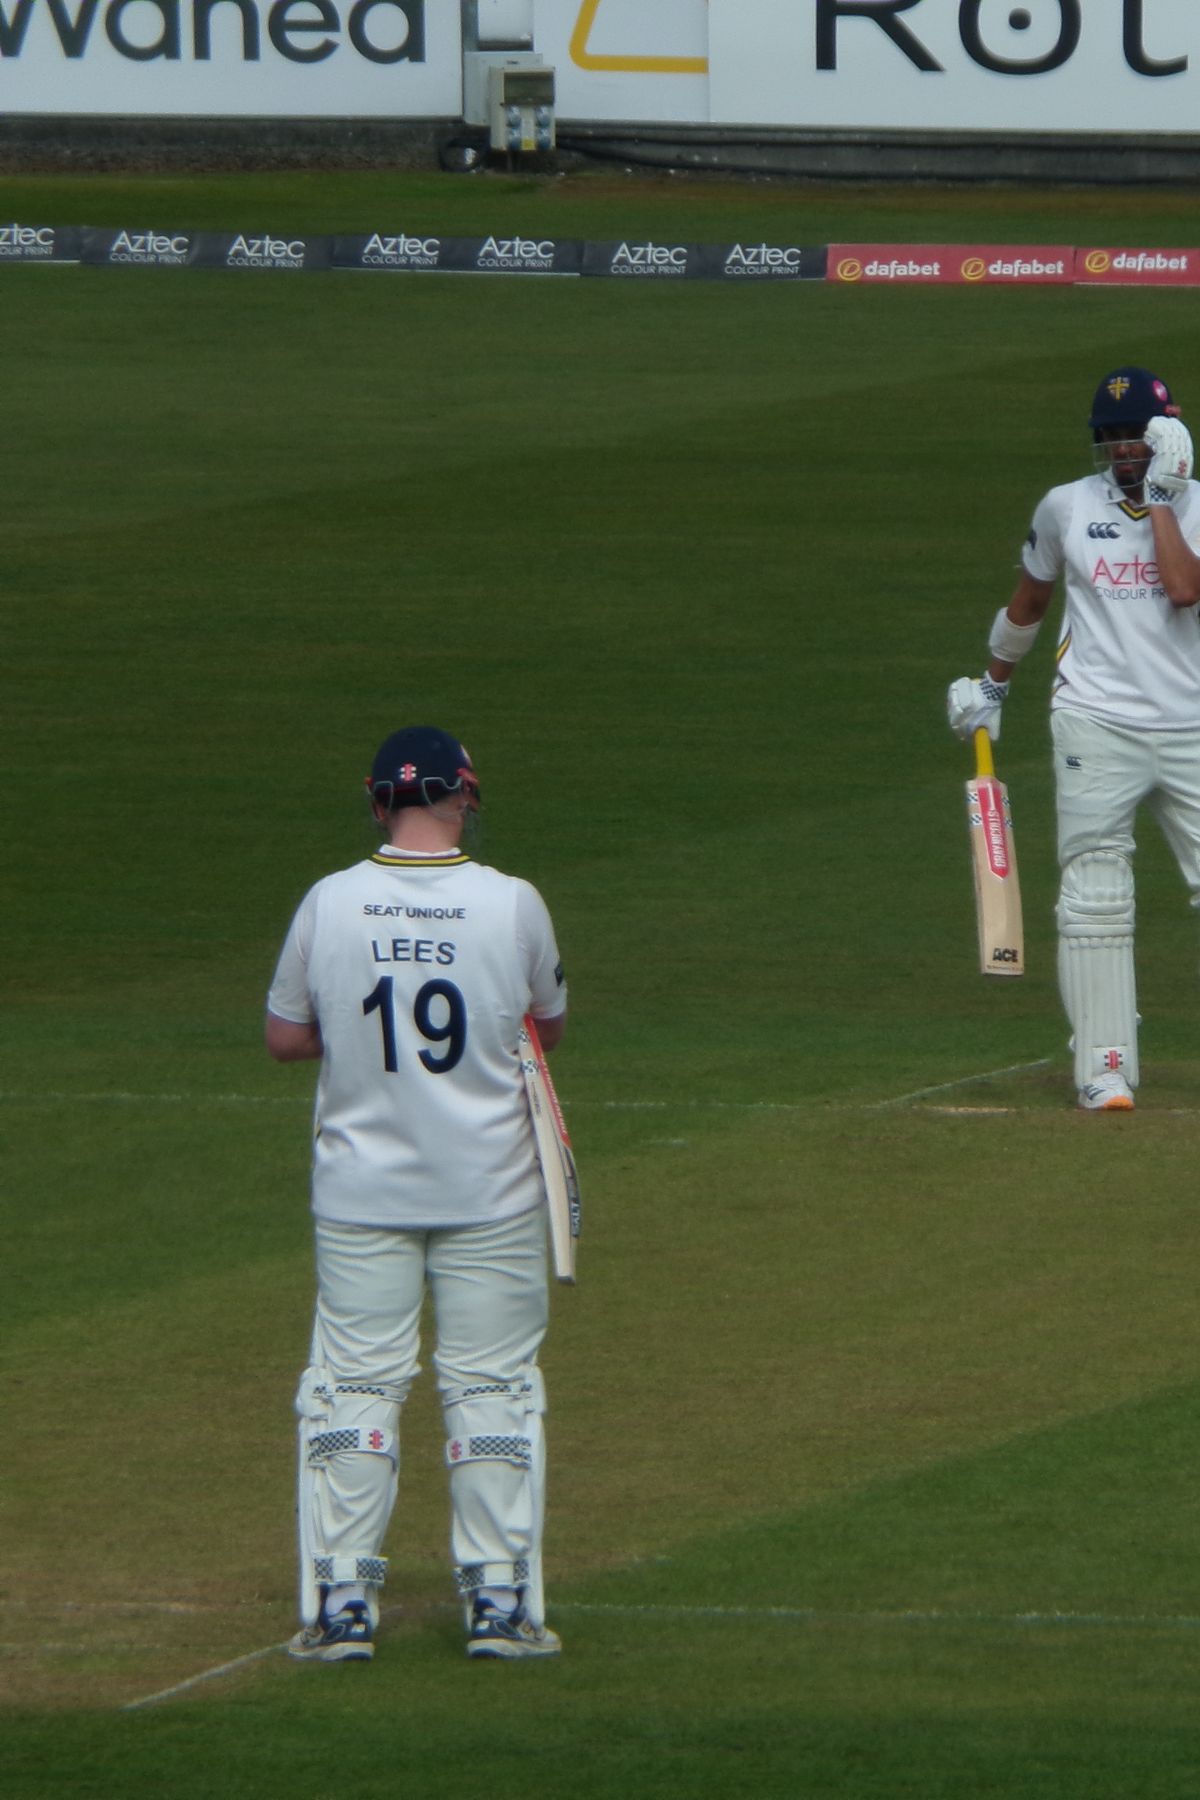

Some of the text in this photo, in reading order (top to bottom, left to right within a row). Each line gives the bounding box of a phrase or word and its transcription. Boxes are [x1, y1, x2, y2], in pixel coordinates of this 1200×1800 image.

[0, 223, 54, 246] ztec
[112, 230, 188, 253] Aztec
[363, 233, 440, 256] Aztec
[229, 235, 305, 258] Aztec
[479, 236, 555, 258] Aztec
[612, 242, 687, 265] Aztec
[726, 243, 801, 266] Aztec
[110, 253, 187, 264] COLOUR PRINT
[227, 257, 304, 268] COLOUR PRINT
[362, 255, 438, 265] COLOUR PRINT
[477, 258, 552, 268] COLOUR PRINT
[989, 260, 1064, 277] dafabet
[1113, 253, 1188, 271] dafabet
[611, 264, 686, 274] COLOUR PRINT
[725, 265, 799, 275] COLOUR PRINT
[865, 260, 940, 278] dafabet
[1092, 554, 1161, 585] Azte
[363, 904, 466, 920] SEAT UNIQUE
[372, 938, 456, 966] LEES
[362, 975, 467, 1074] 19
